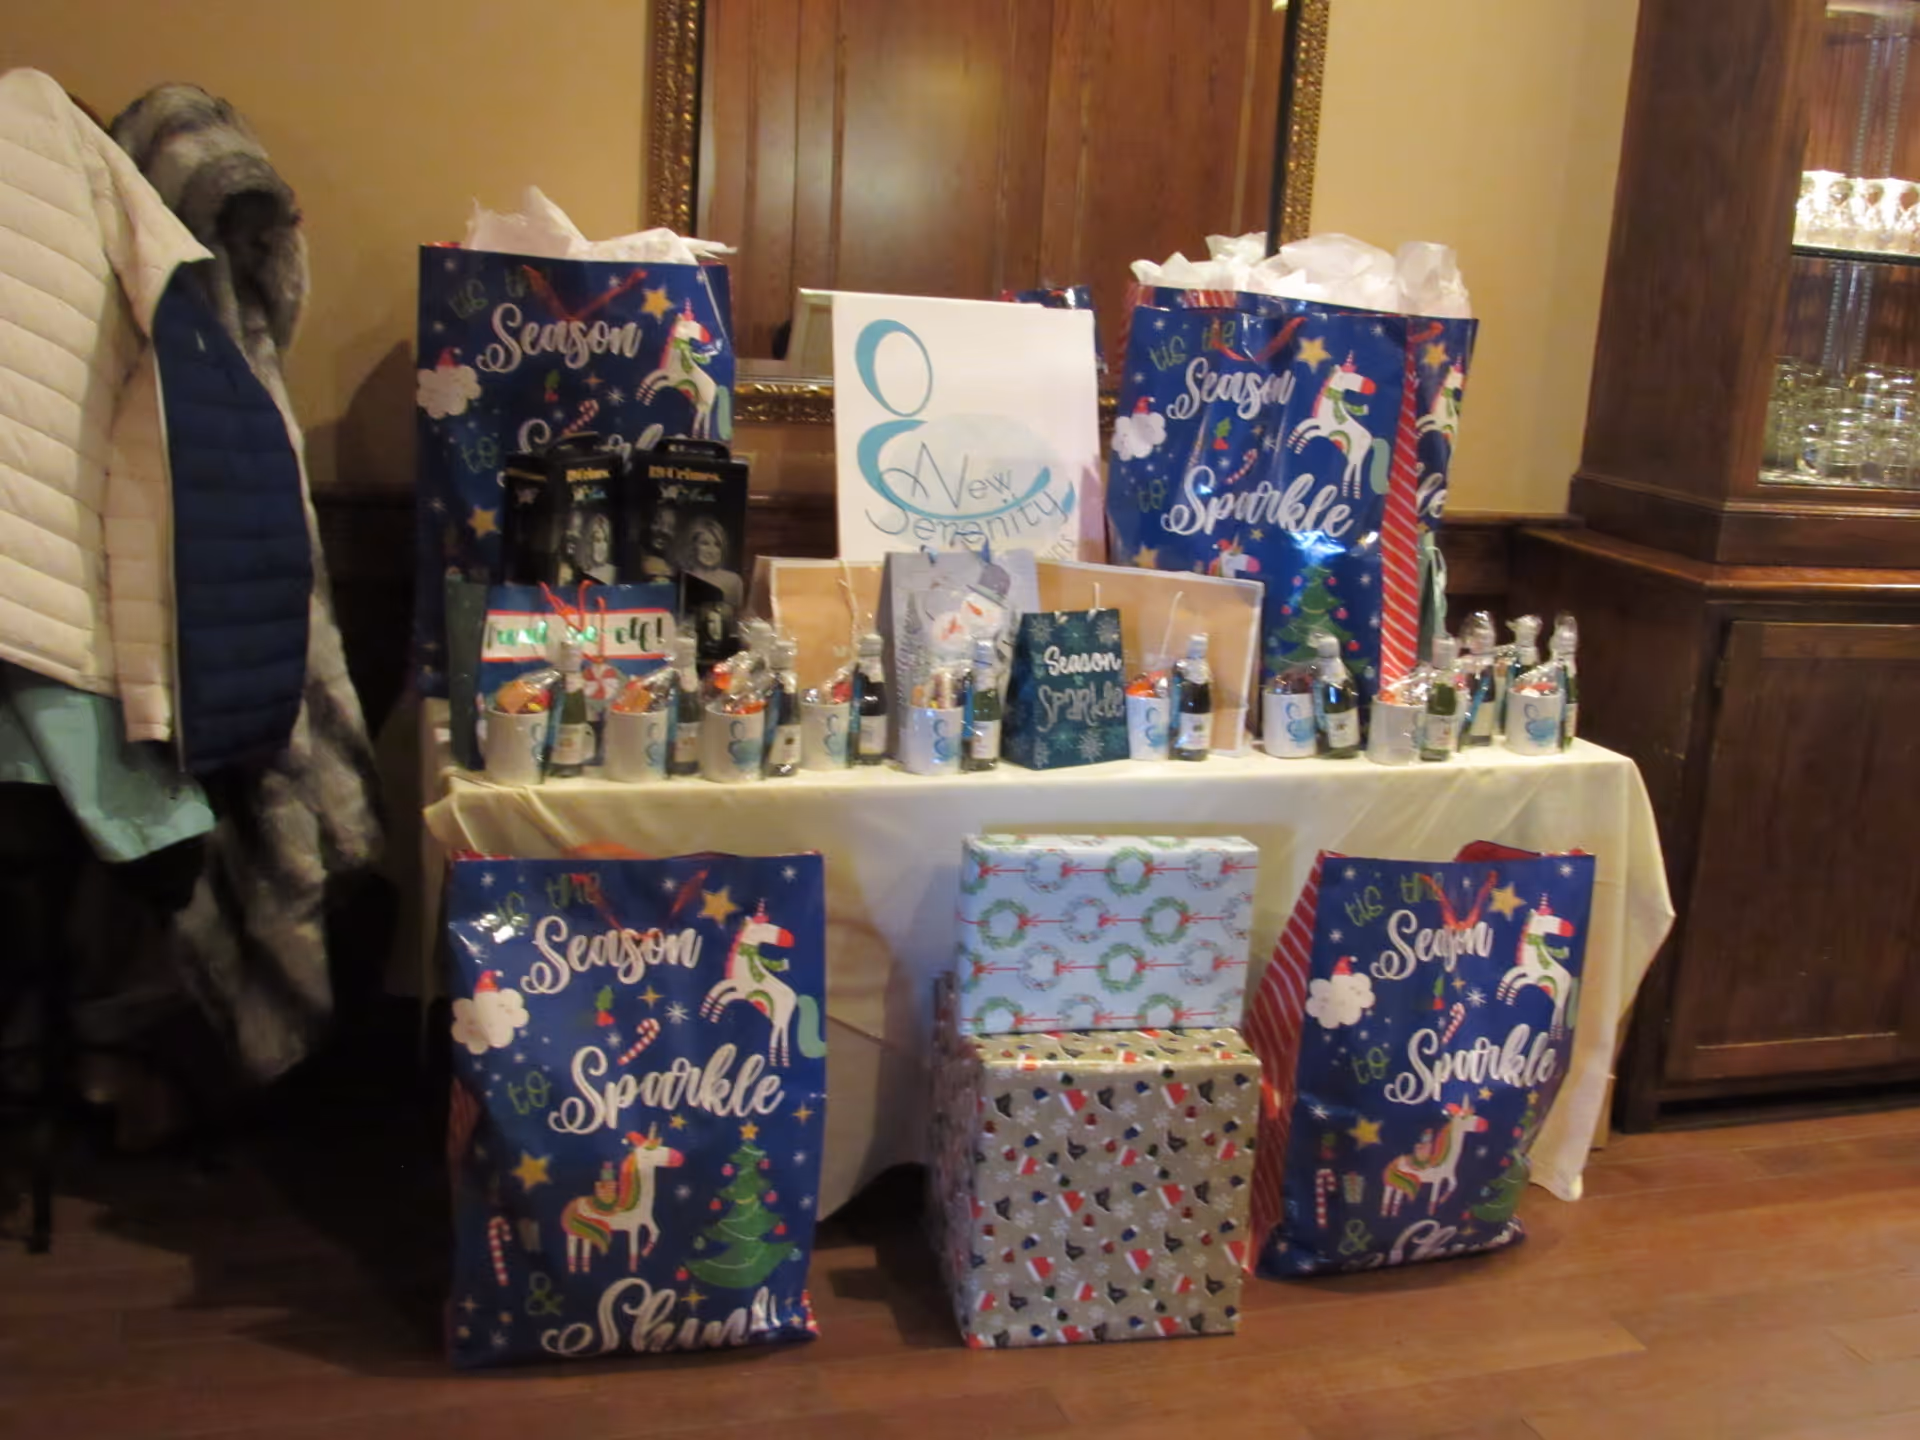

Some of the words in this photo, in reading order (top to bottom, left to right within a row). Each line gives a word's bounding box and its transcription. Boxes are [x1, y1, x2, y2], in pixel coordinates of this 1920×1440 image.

[476, 303, 643, 374] Season
[1166, 356, 1297, 420] Season
[865, 467, 1070, 545] Serenity
[911, 440, 1012, 510] New
[1161, 465, 1355, 536] Sparkle
[1043, 645, 1122, 676] Season
[520, 916, 702, 994] Season
[507, 1071, 552, 1114] to
[548, 1043, 785, 1135] Sparkle
[1384, 1023, 1558, 1105] Sparkle
